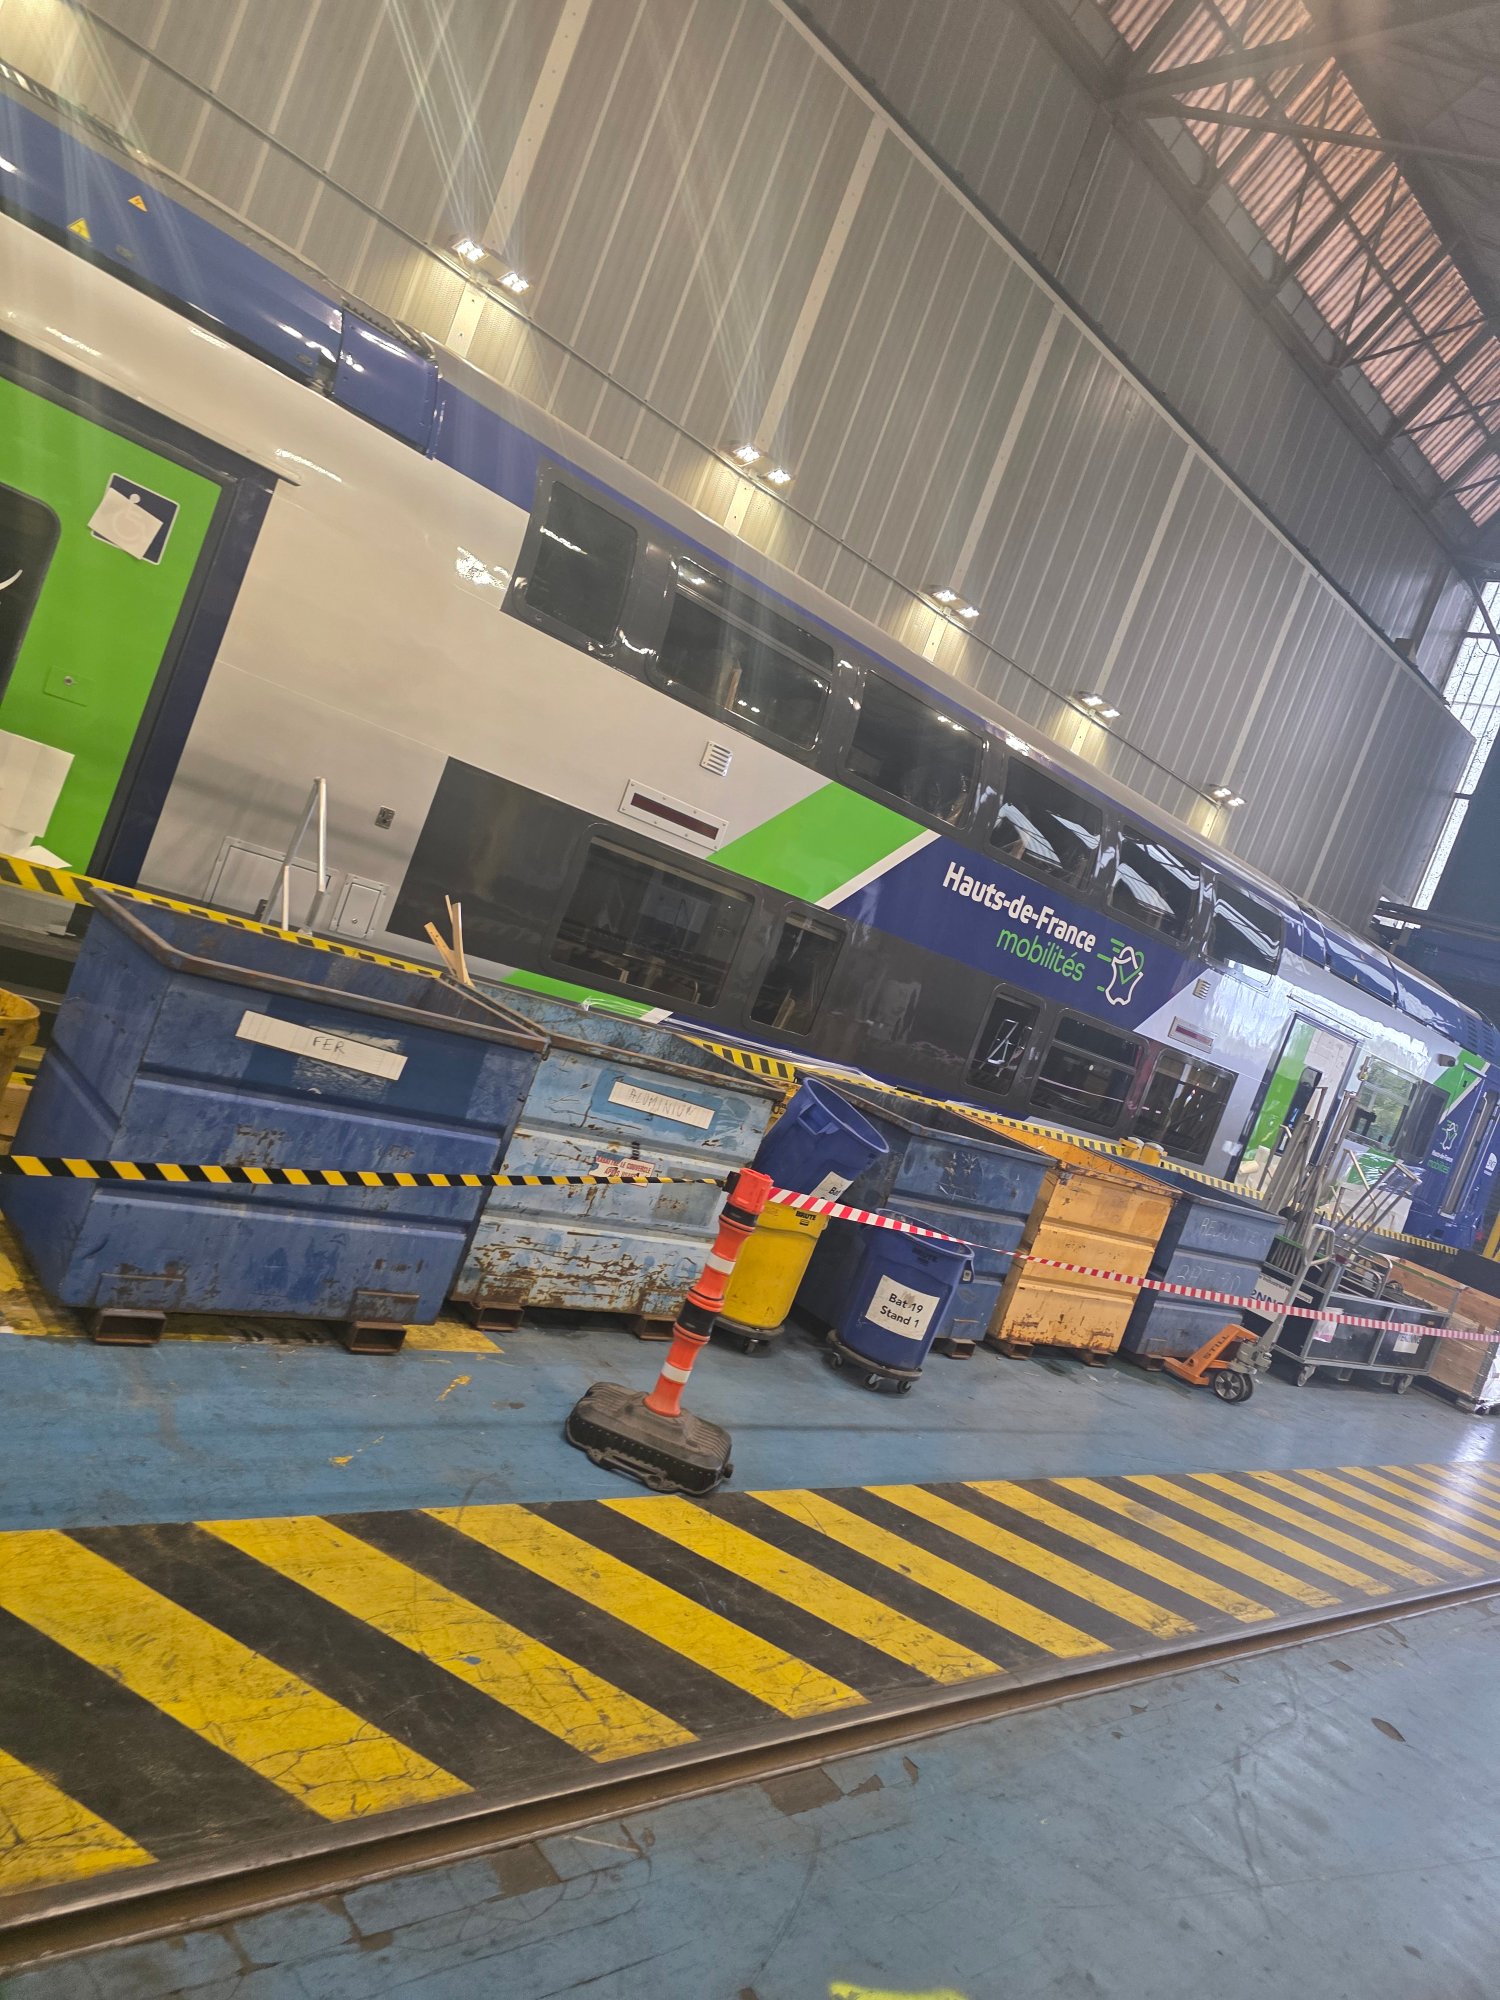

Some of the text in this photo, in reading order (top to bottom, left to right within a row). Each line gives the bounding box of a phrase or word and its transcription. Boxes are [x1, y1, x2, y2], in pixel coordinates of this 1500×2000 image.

[942, 861, 1096, 953] Hauts-de-France
[996, 928, 1086, 982] mobilités
[312, 1036, 345, 1054] FER
[888, 1293, 924, 1314] Bat 19
[880, 1305, 912, 1326] Stand
[1203, 1334, 1229, 1359] STILL
